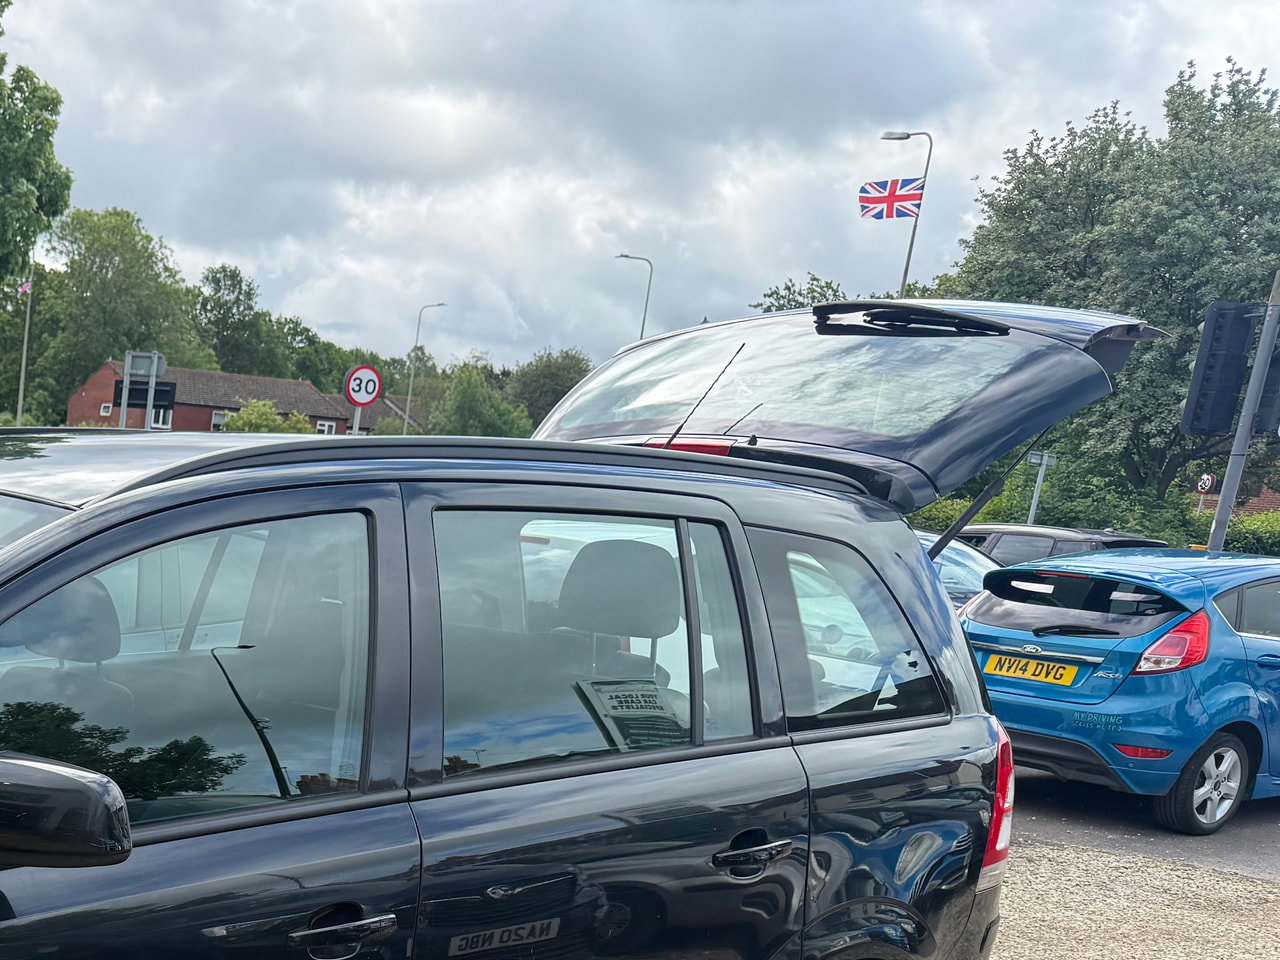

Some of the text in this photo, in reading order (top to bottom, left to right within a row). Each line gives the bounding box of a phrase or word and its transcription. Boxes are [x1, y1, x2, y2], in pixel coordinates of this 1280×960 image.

[351, 377, 377, 395] 30
[993, 657, 1067, 681] NV14 DVG
[1072, 711, 1123, 725] MY DRIVING
